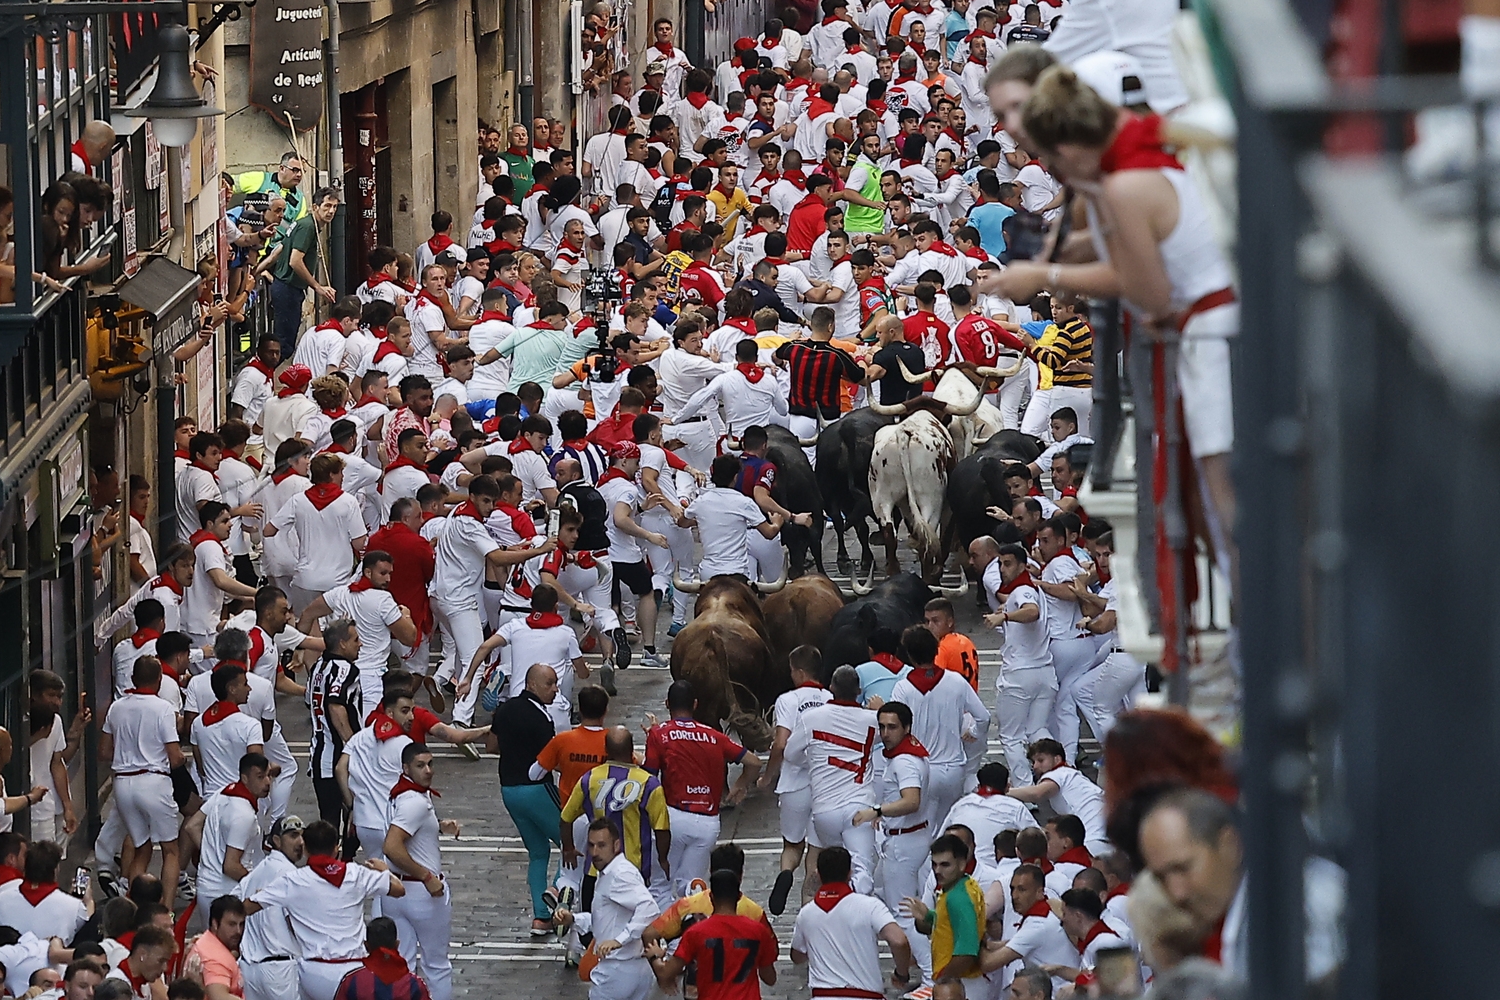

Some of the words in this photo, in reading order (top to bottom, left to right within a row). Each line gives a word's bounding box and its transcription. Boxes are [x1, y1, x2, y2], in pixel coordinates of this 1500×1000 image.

[275, 4, 322, 23] Jugueterí
[273, 72, 292, 87] de
[981, 330, 996, 359] 8
[669, 730, 710, 743] CORELLA
[594, 777, 642, 812] 19
[705, 937, 760, 984] 17
